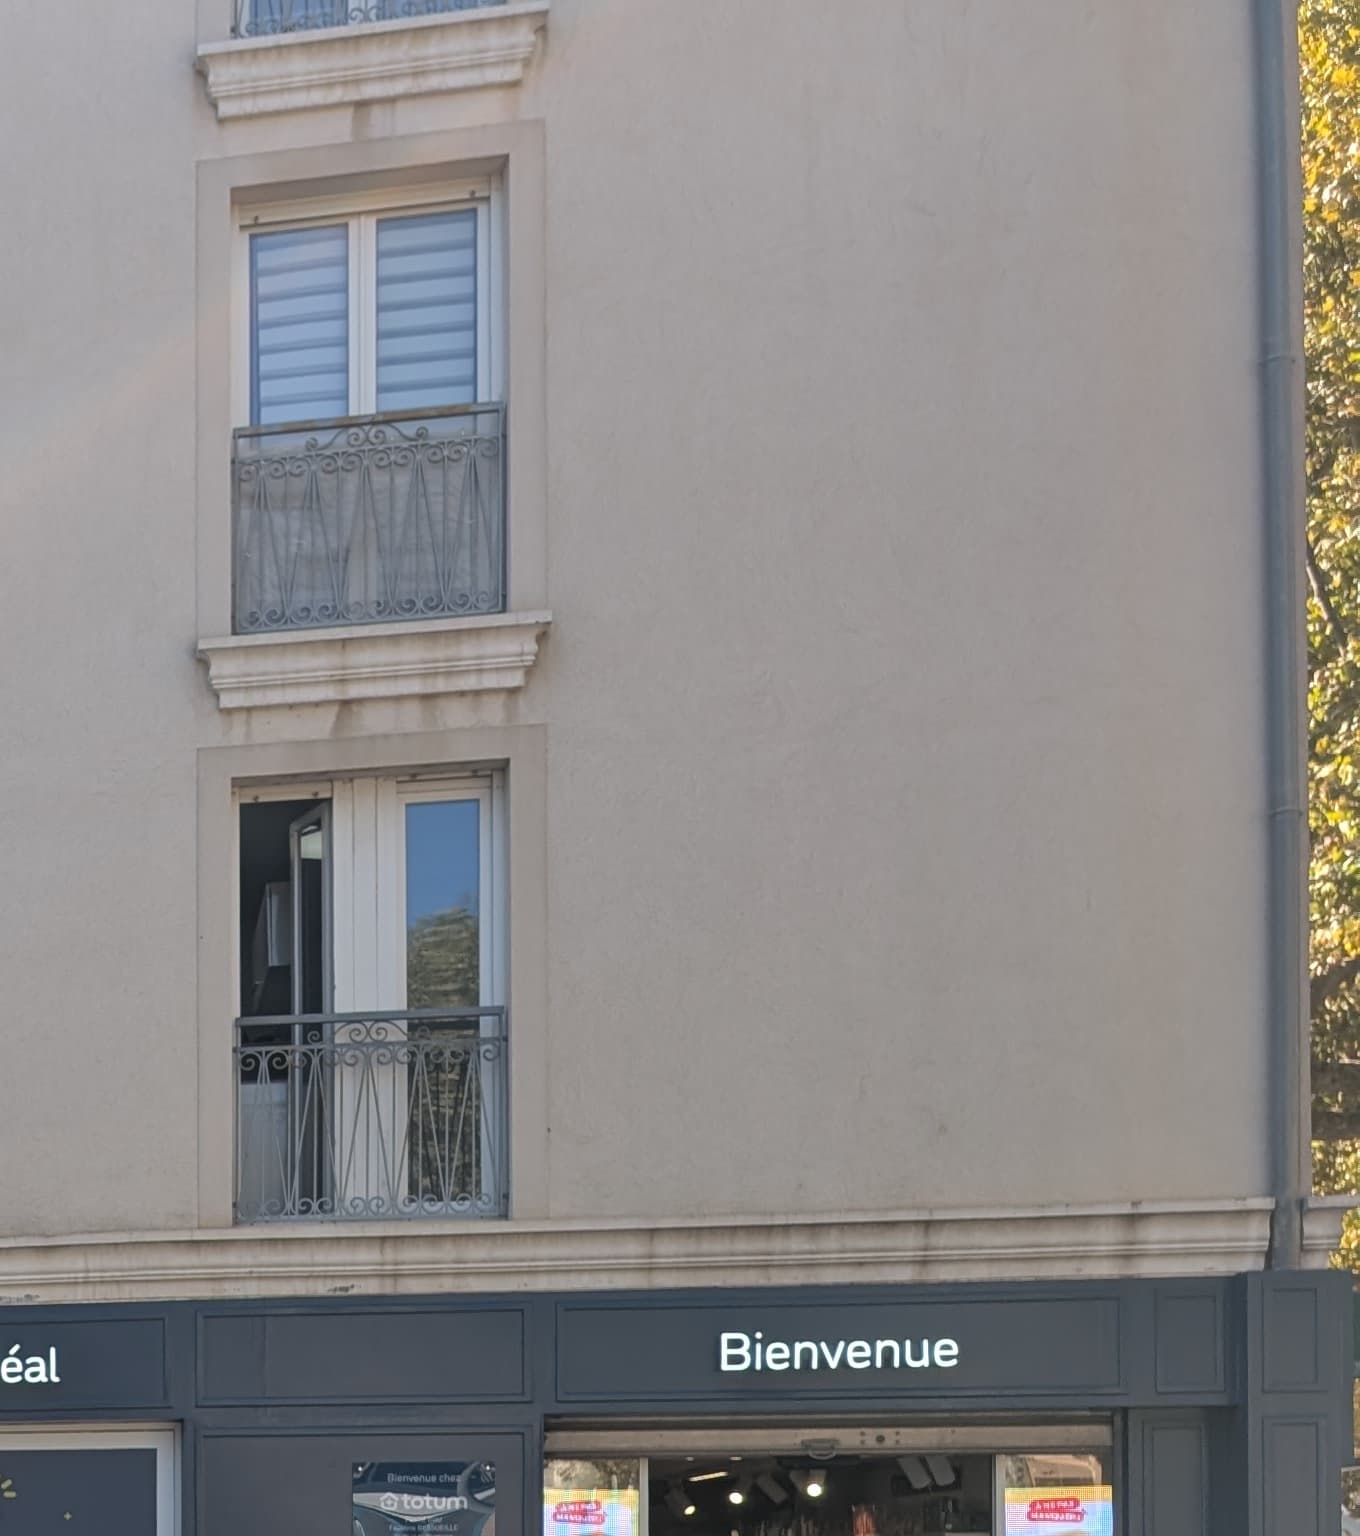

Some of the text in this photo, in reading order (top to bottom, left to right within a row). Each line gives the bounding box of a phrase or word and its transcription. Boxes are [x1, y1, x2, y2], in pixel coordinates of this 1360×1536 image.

[720, 1333, 959, 1371] Bienvenue
[387, 1473, 461, 1483] Bienvenue chez
[403, 1493, 468, 1509] totum
